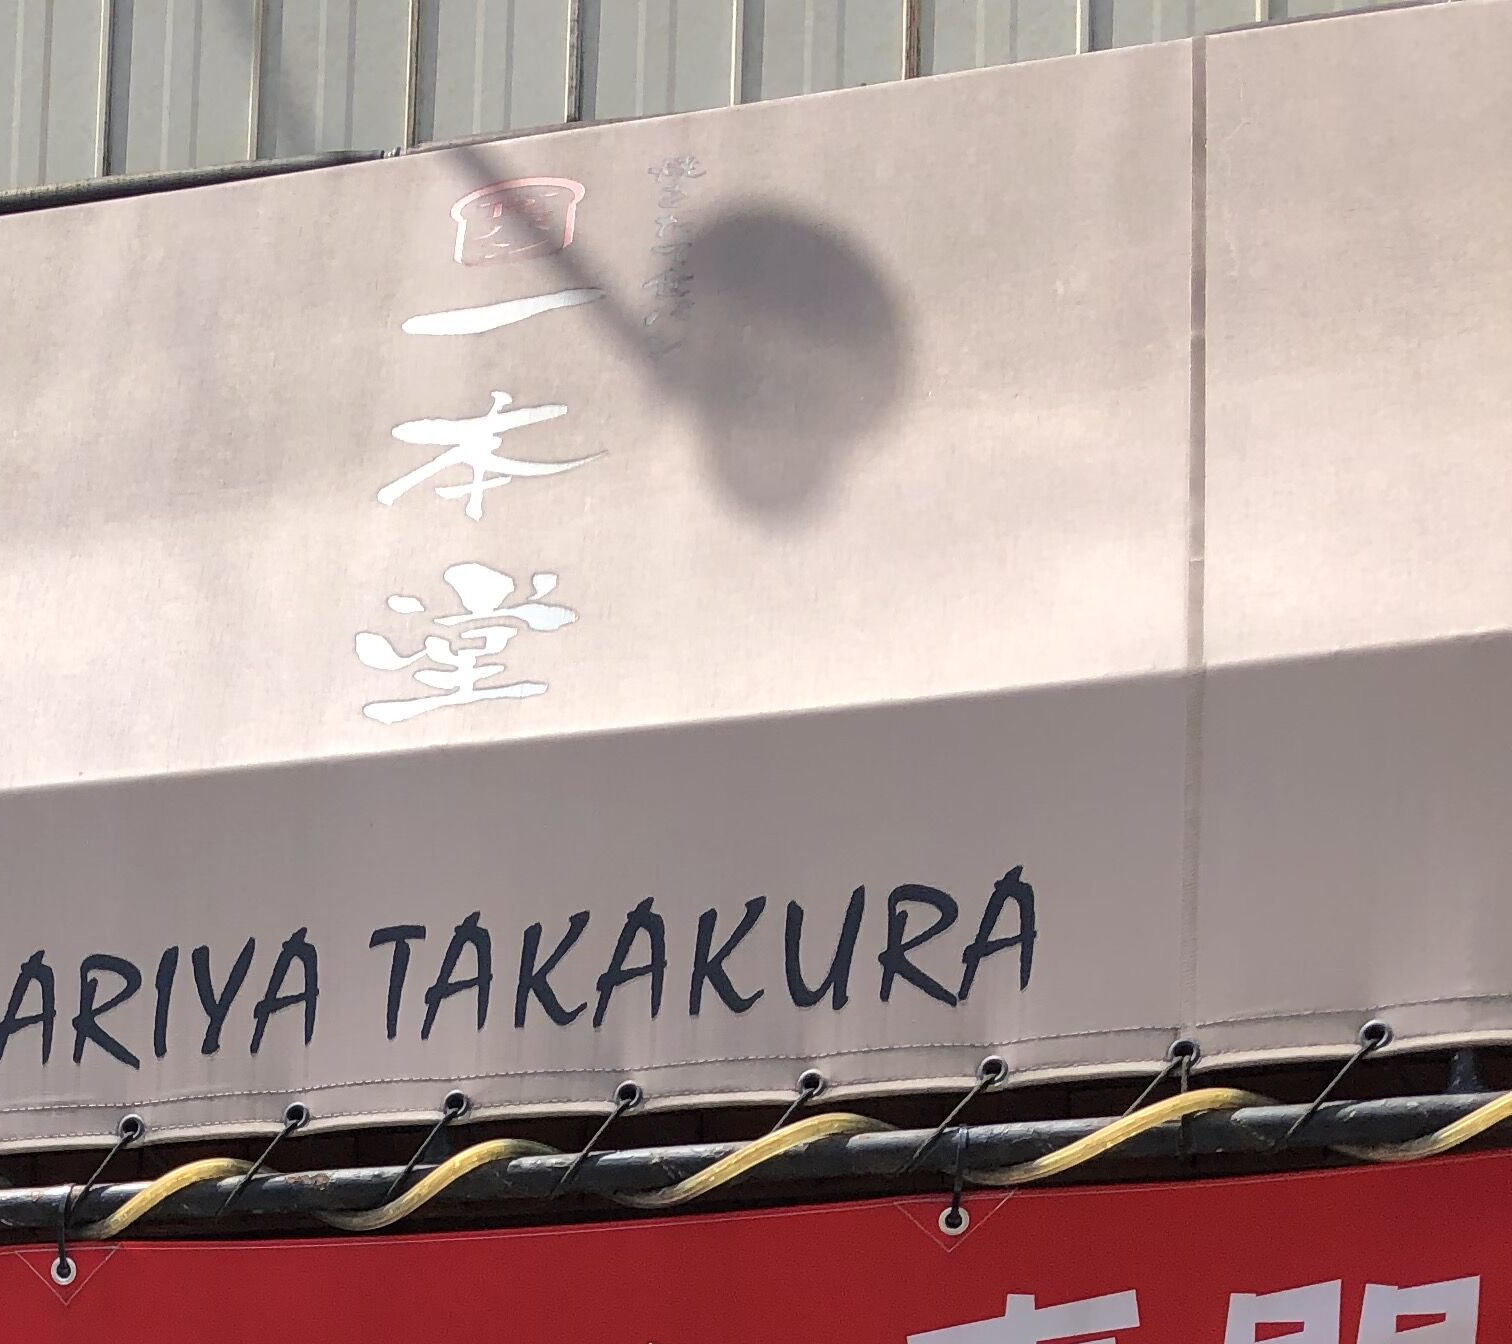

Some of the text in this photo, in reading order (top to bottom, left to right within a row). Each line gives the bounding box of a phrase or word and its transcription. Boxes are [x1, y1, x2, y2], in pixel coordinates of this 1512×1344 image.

[354, 286, 607, 724] 一本堂
[369, 864, 1038, 1042] TAKAKURA
